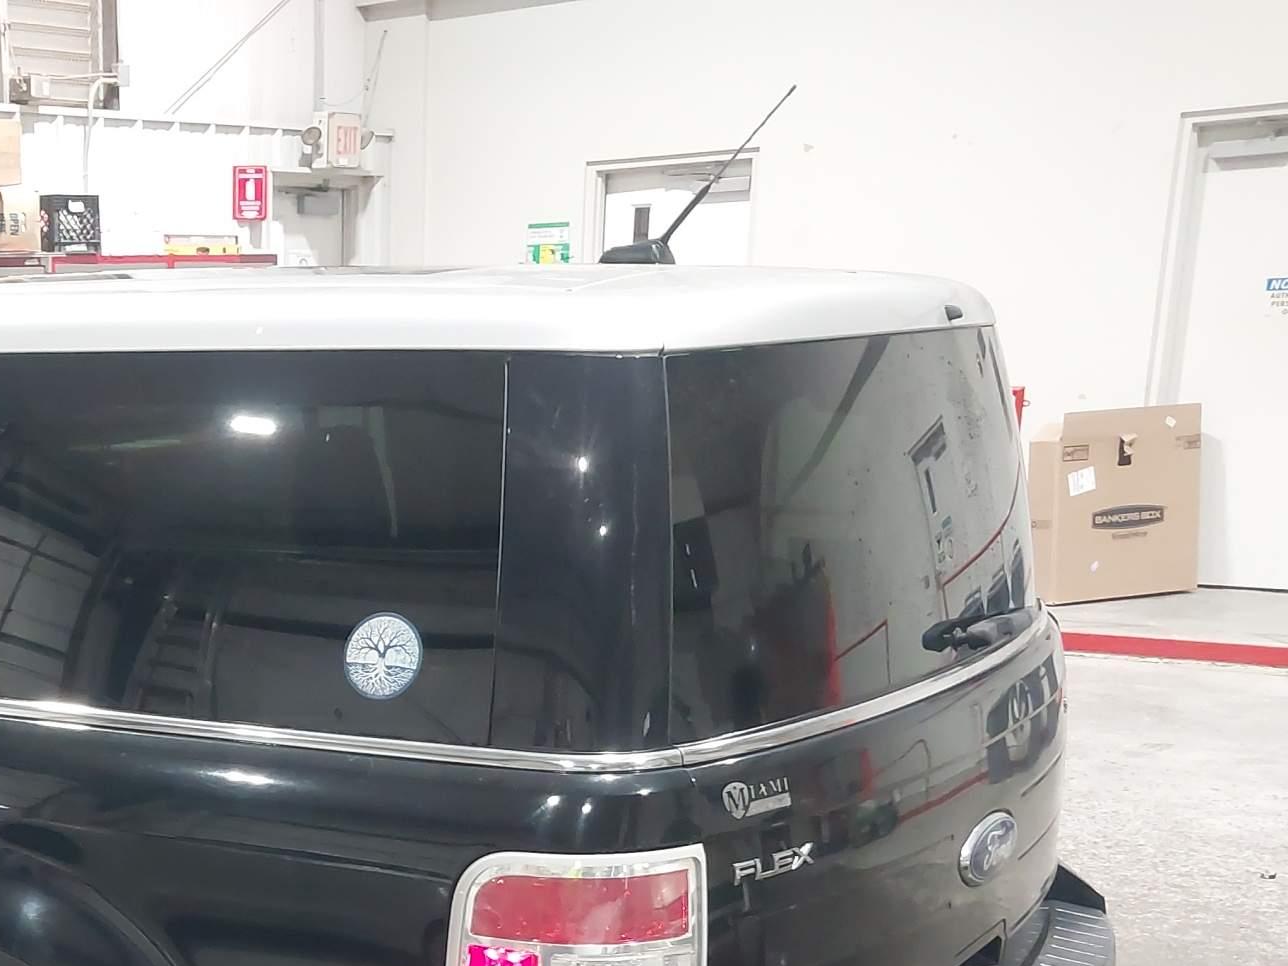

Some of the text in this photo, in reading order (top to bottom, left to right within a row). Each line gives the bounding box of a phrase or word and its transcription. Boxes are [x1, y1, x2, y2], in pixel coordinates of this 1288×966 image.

[336, 125, 358, 155] EXIT
[9, 212, 20, 236] OPEN
[1094, 510, 1161, 524] BANKERS BOX
[722, 776, 790, 818] MIAMI
[732, 841, 814, 886] FLEX
